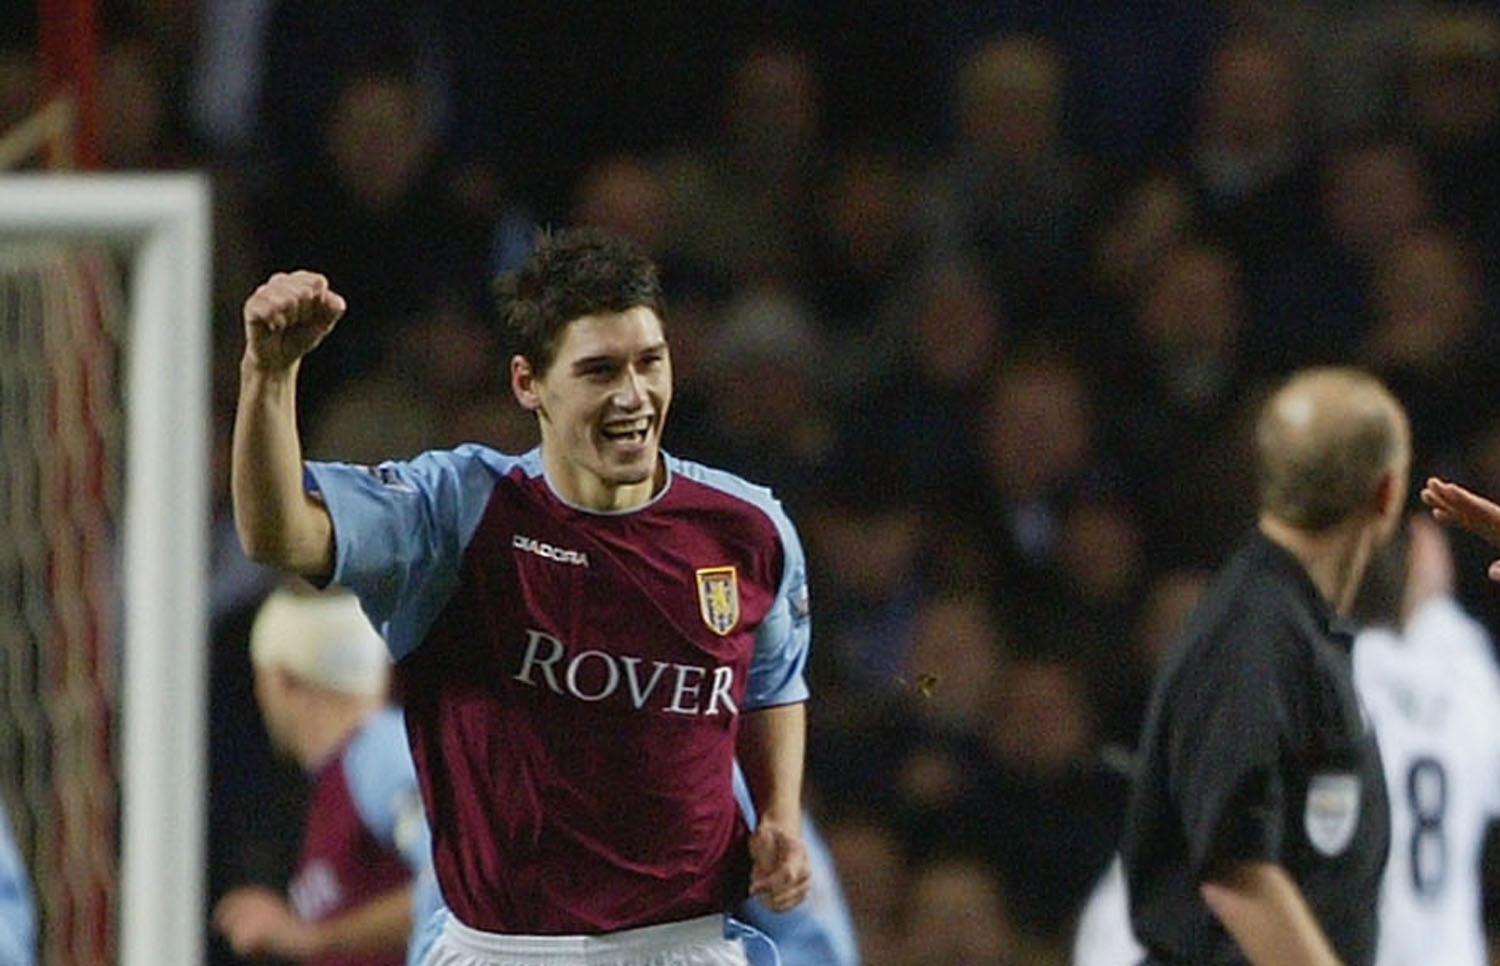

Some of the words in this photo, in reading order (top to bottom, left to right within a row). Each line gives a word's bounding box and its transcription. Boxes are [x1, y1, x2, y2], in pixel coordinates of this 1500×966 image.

[511, 534, 589, 568] DIADORA
[513, 629, 739, 716] ROVER
[1406, 754, 1447, 902] 8
